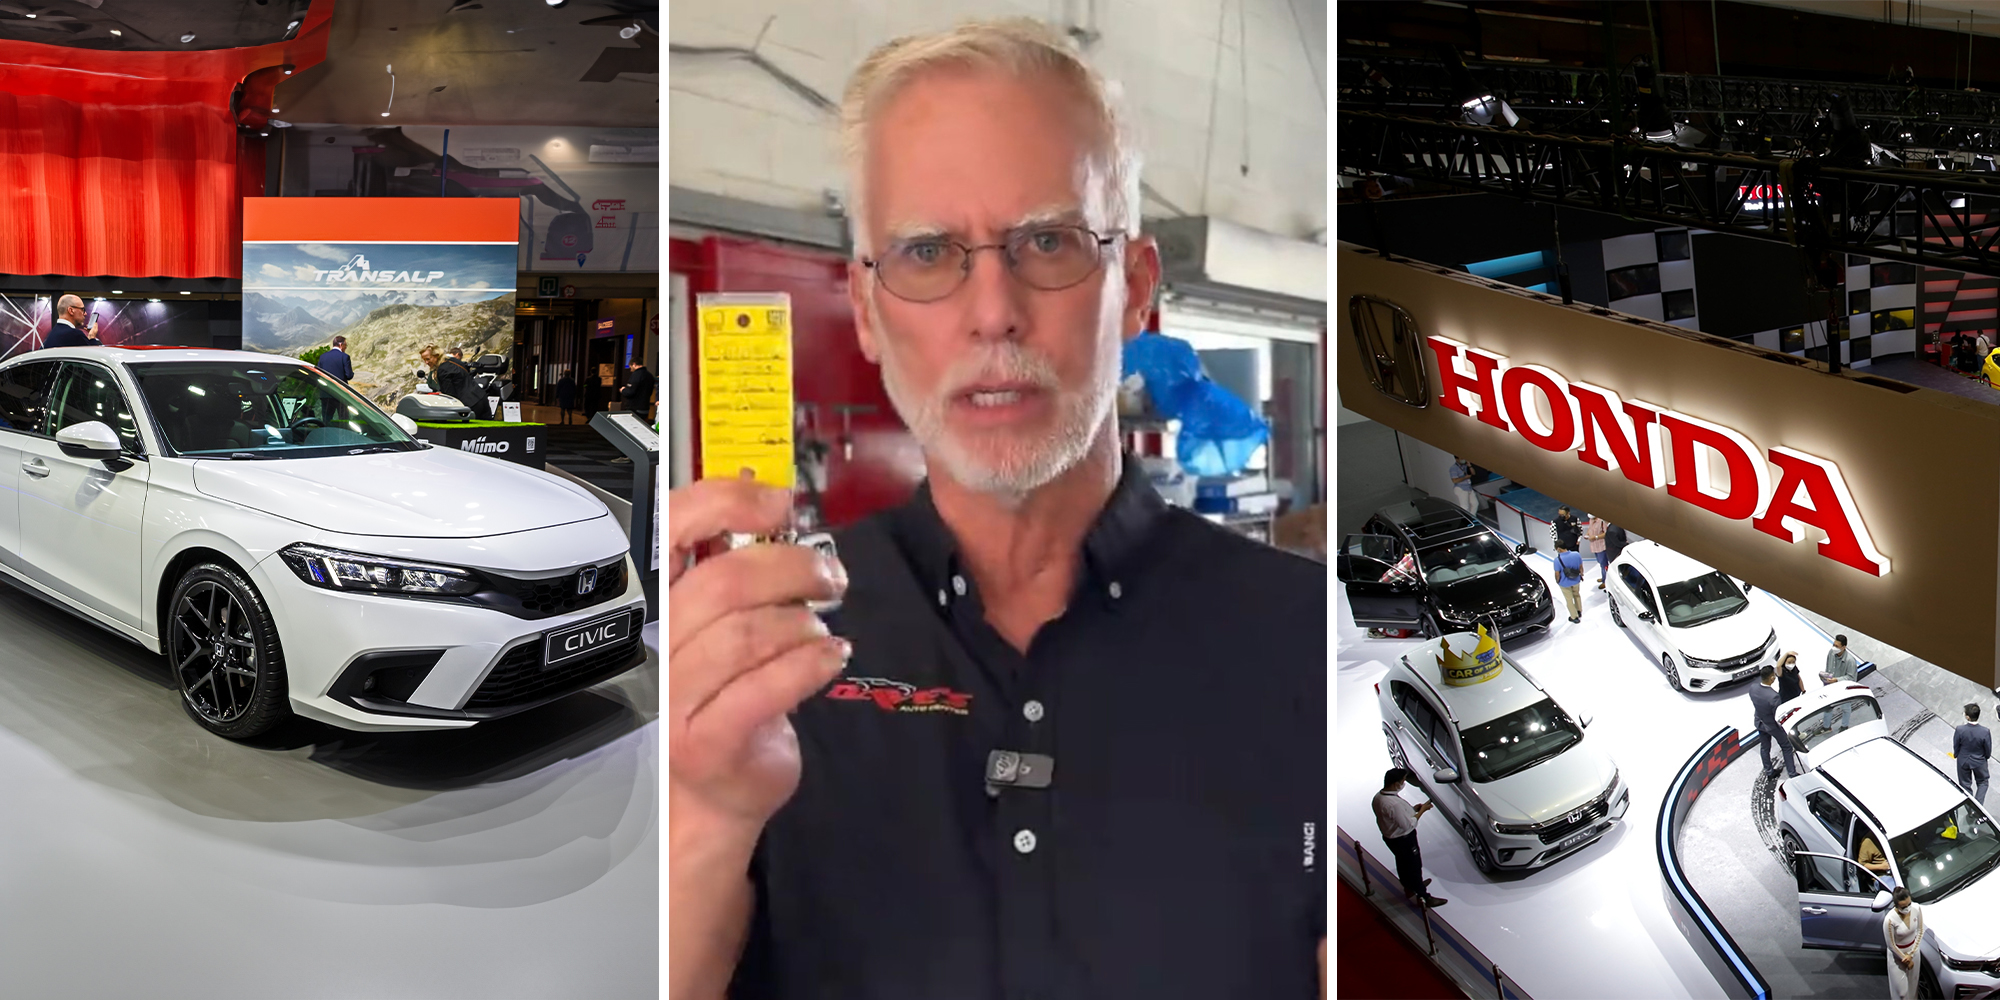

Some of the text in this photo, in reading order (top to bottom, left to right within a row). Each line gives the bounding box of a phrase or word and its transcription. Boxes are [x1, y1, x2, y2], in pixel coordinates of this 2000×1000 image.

[313, 269, 445, 284] TRANSALP
[1428, 335, 1892, 578] HONDA
[565, 622, 616, 651] CIVIC
[1502, 628, 1522, 638] CR-V
[1448, 668, 1473, 678] CAR
[1485, 661, 1497, 670] THE
